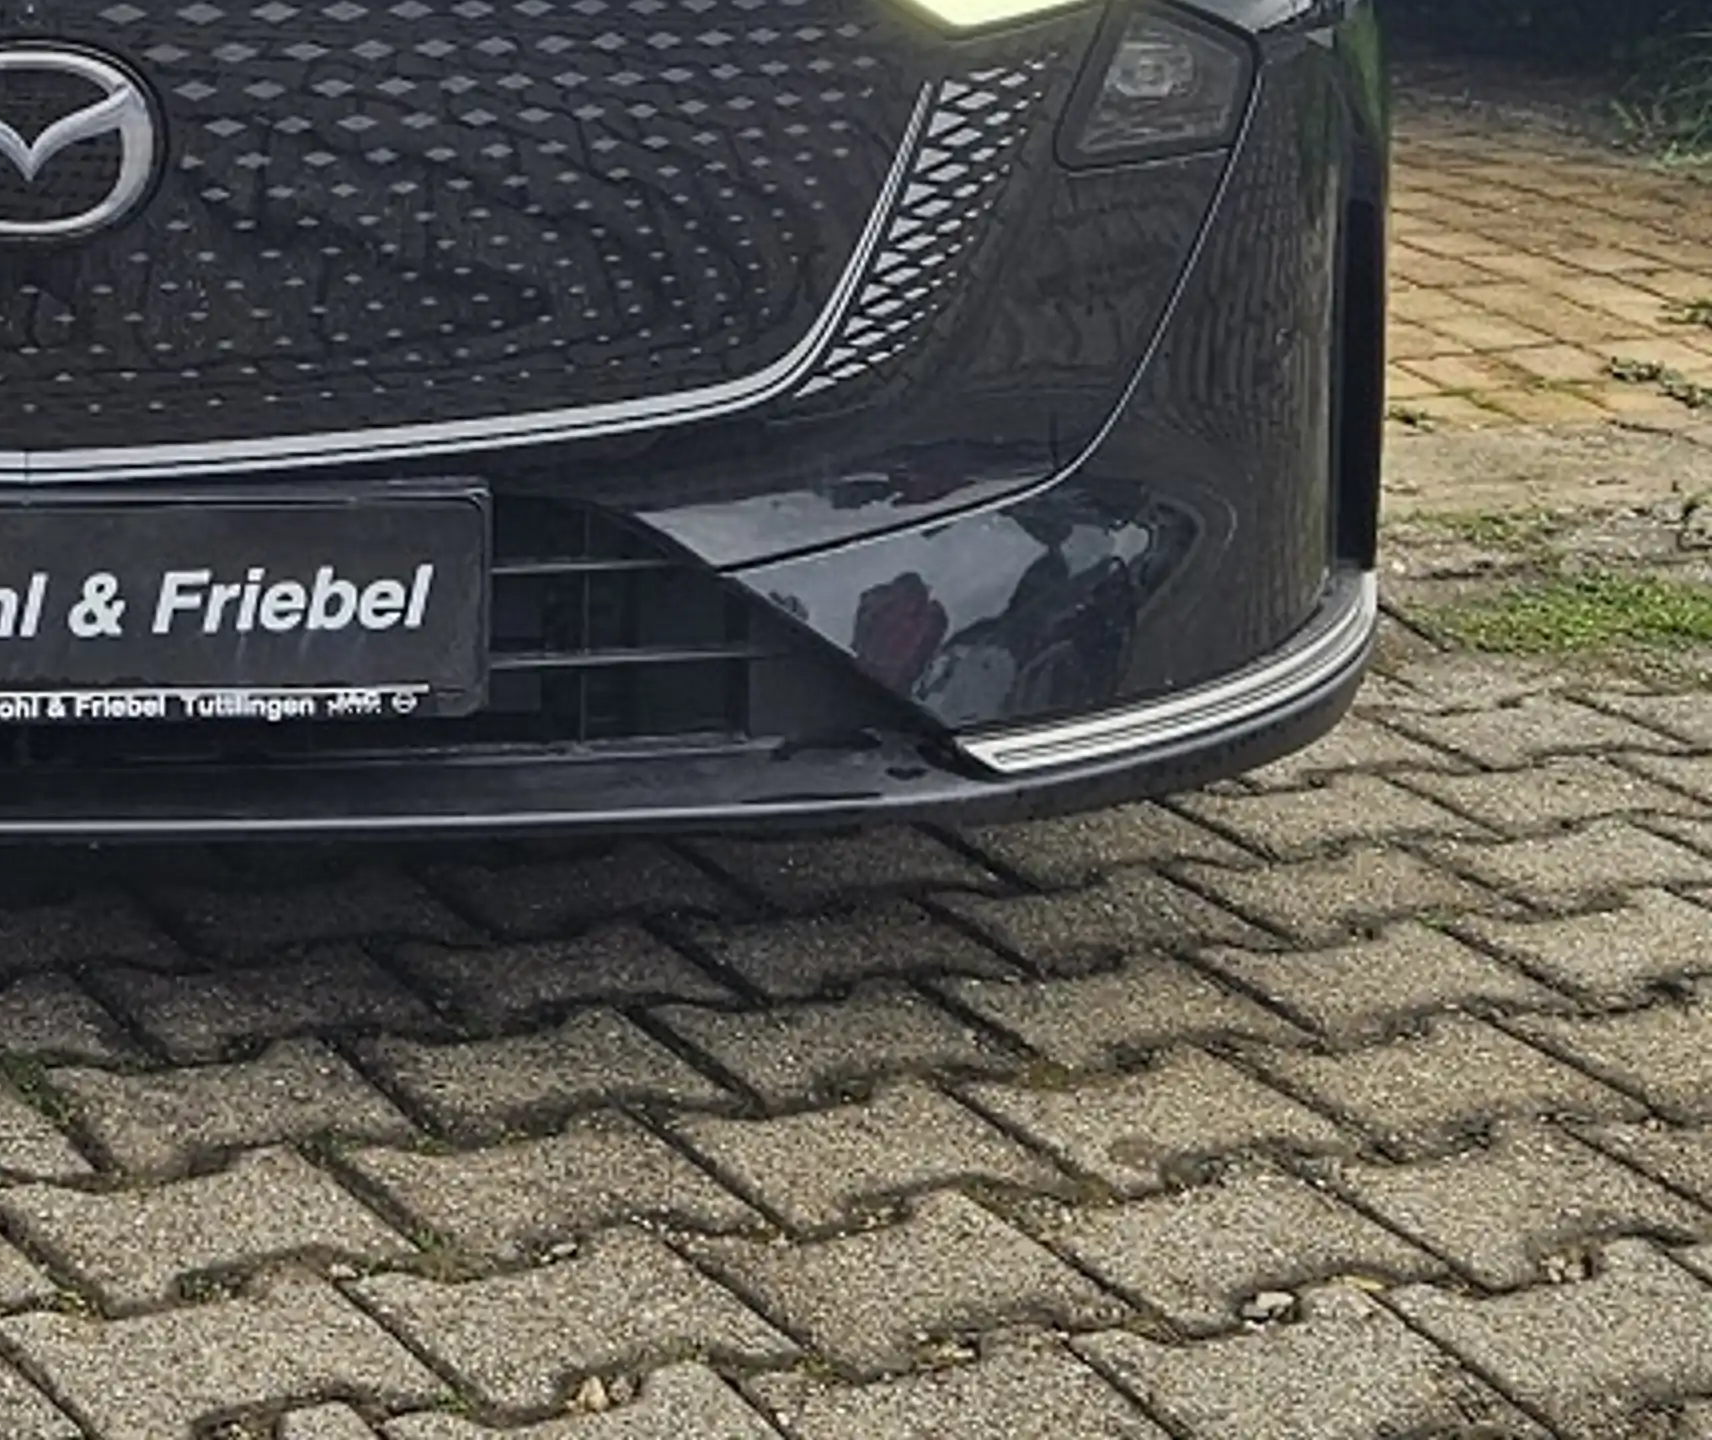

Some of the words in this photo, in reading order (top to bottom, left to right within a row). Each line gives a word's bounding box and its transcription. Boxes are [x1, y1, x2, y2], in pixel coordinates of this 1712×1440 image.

[68, 572, 126, 638] &
[152, 563, 434, 634] Friebel
[47, 696, 66, 718] &
[75, 693, 166, 718] Friebel
[179, 691, 316, 722] Tuttlingen
